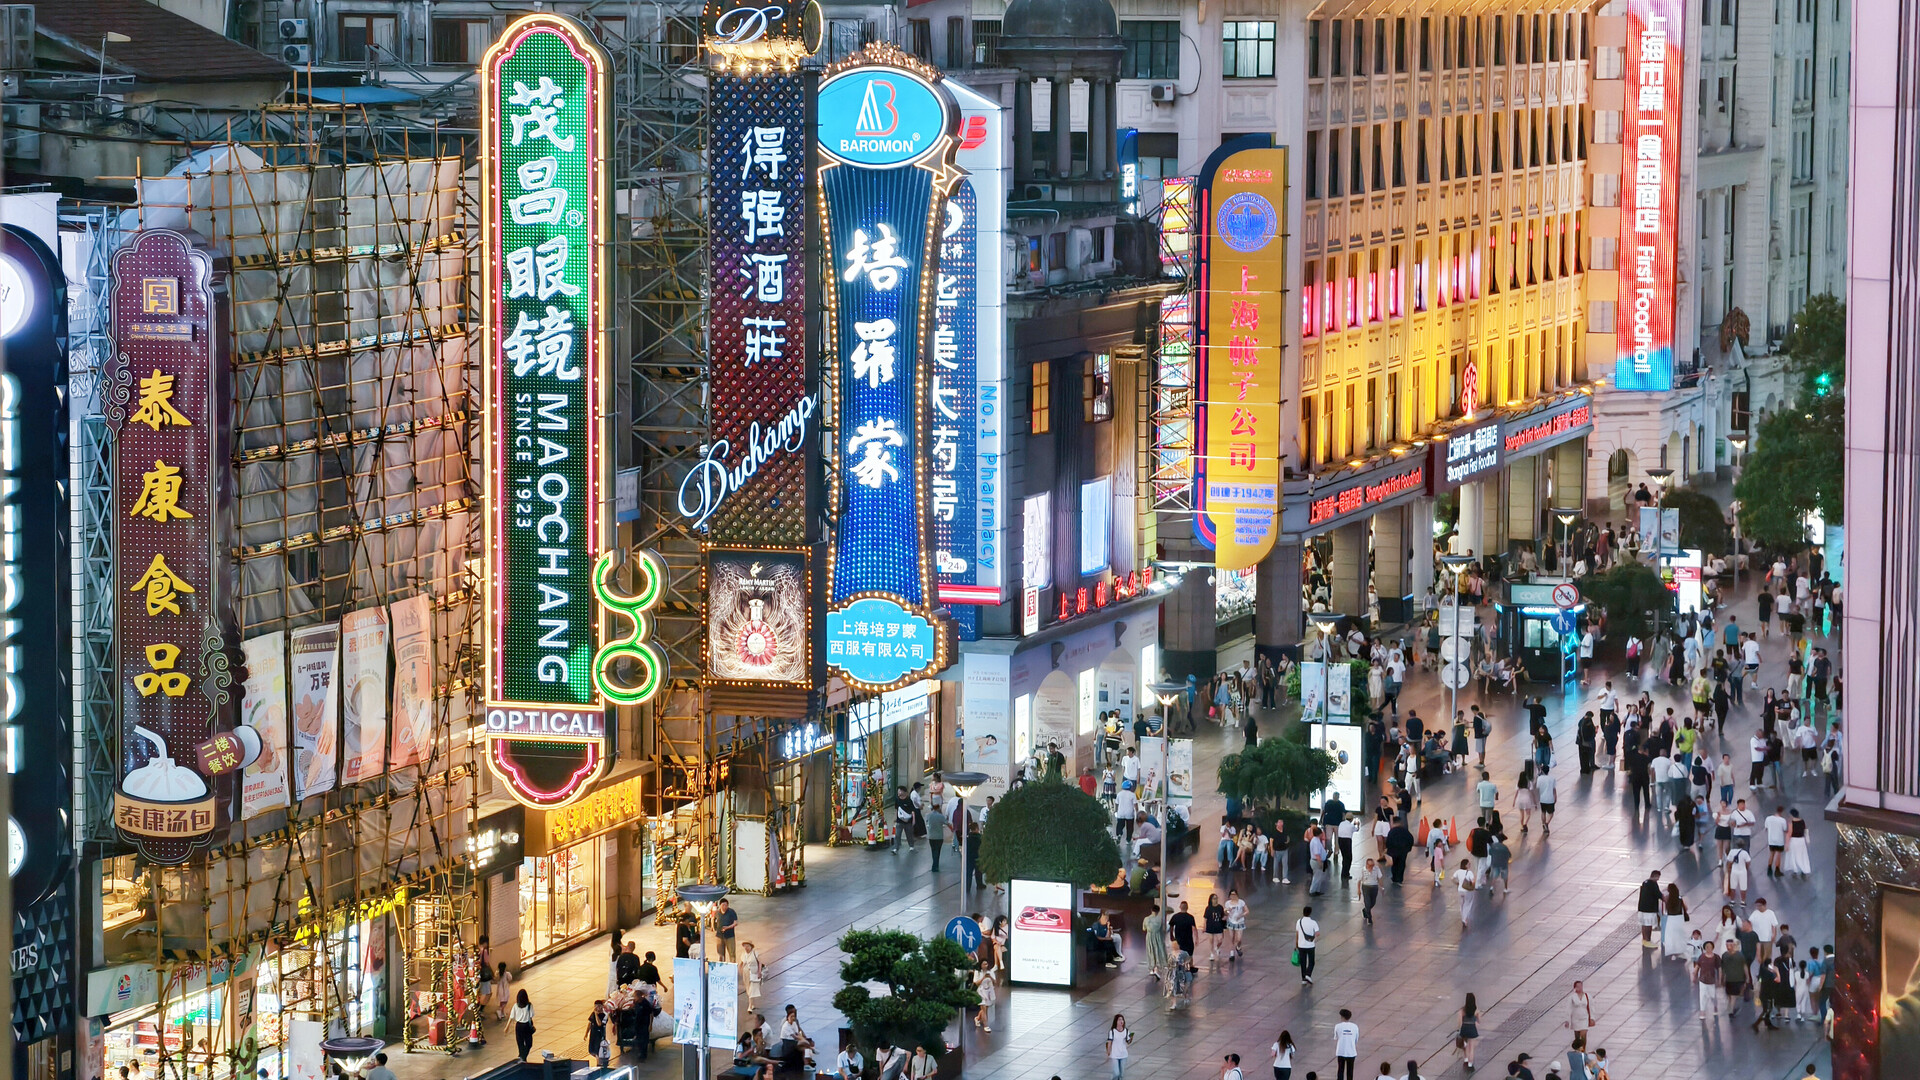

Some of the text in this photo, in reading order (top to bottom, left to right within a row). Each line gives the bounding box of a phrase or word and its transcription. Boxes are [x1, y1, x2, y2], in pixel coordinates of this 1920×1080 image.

[1635, 11, 1667, 233] 上海市第一食品商店
[840, 138, 913, 153] BAROMON
[503, 76, 580, 381] 茂昌眼镜
[1634, 246, 1655, 373] First Foodhall
[1447, 425, 1498, 462] 上海市第一食品商店
[1505, 428, 1526, 451] Shanghai
[1534, 420, 1552, 441] Foodhall
[515, 393, 532, 528] SINCE 1923
[978, 385, 998, 569] No.1 Pharmacy
[1447, 459, 1469, 482] Shanghai
[1478, 450, 1497, 470] Foodhall
[1365, 478, 1391, 503] Shanghai
[1400, 466, 1422, 489] Foodhall
[129, 368, 195, 698] 泰康食品
[536, 393, 570, 684] MAOCHANG
[837, 619, 917, 639] 上海培罗蒙
[830, 640, 924, 660] 西服有限公司
[487, 710, 600, 735] OPTICAL
[201, 736, 231, 758] 二楼
[207, 752, 238, 774] 餐饮
[119, 804, 211, 834] 泰康汤包
